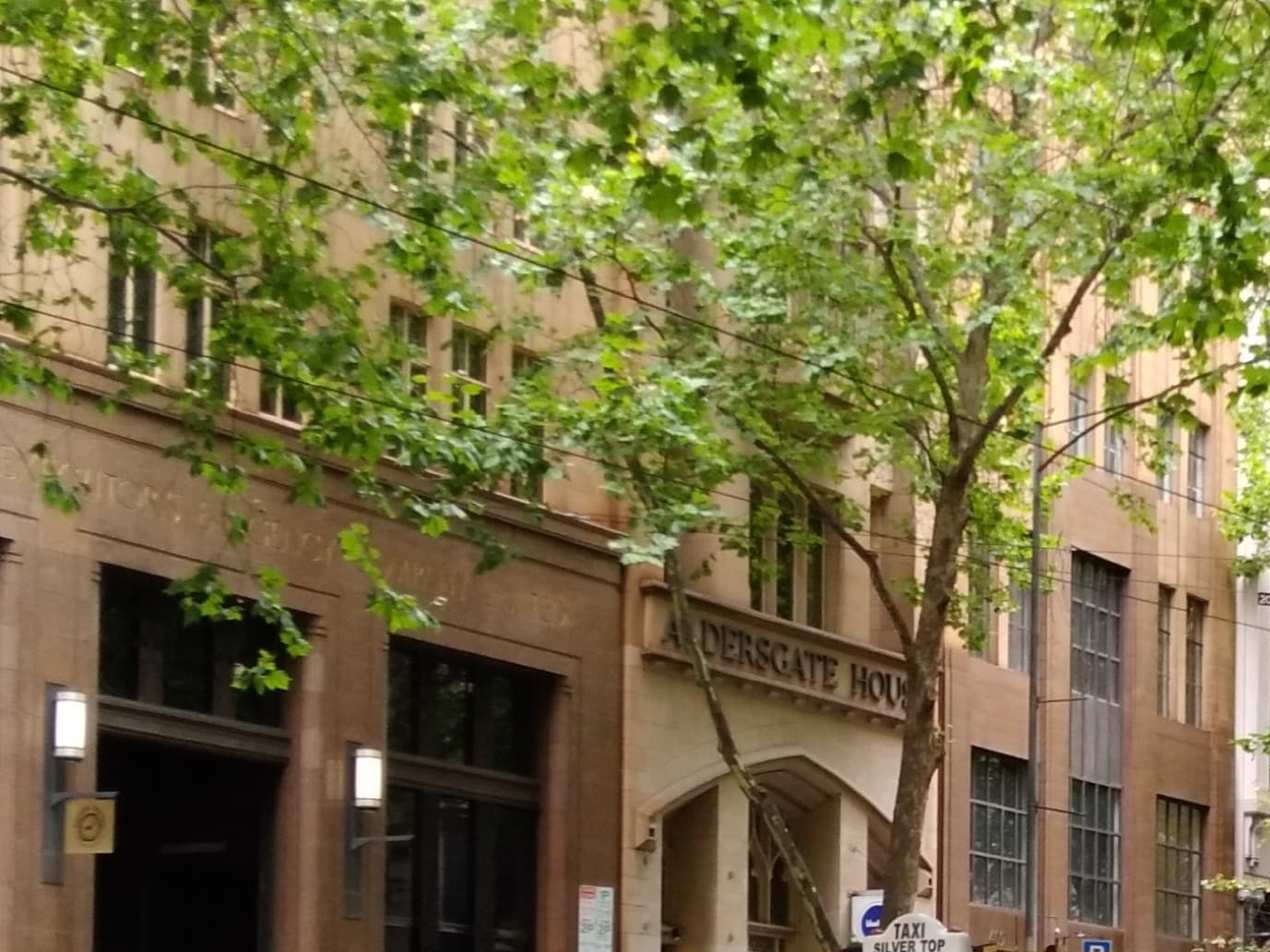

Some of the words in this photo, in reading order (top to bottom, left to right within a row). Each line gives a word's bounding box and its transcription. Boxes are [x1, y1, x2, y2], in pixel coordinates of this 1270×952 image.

[661, 616, 839, 689] ADERSGATE
[894, 923, 925, 939] TAXI
[921, 940, 945, 952] TOP
